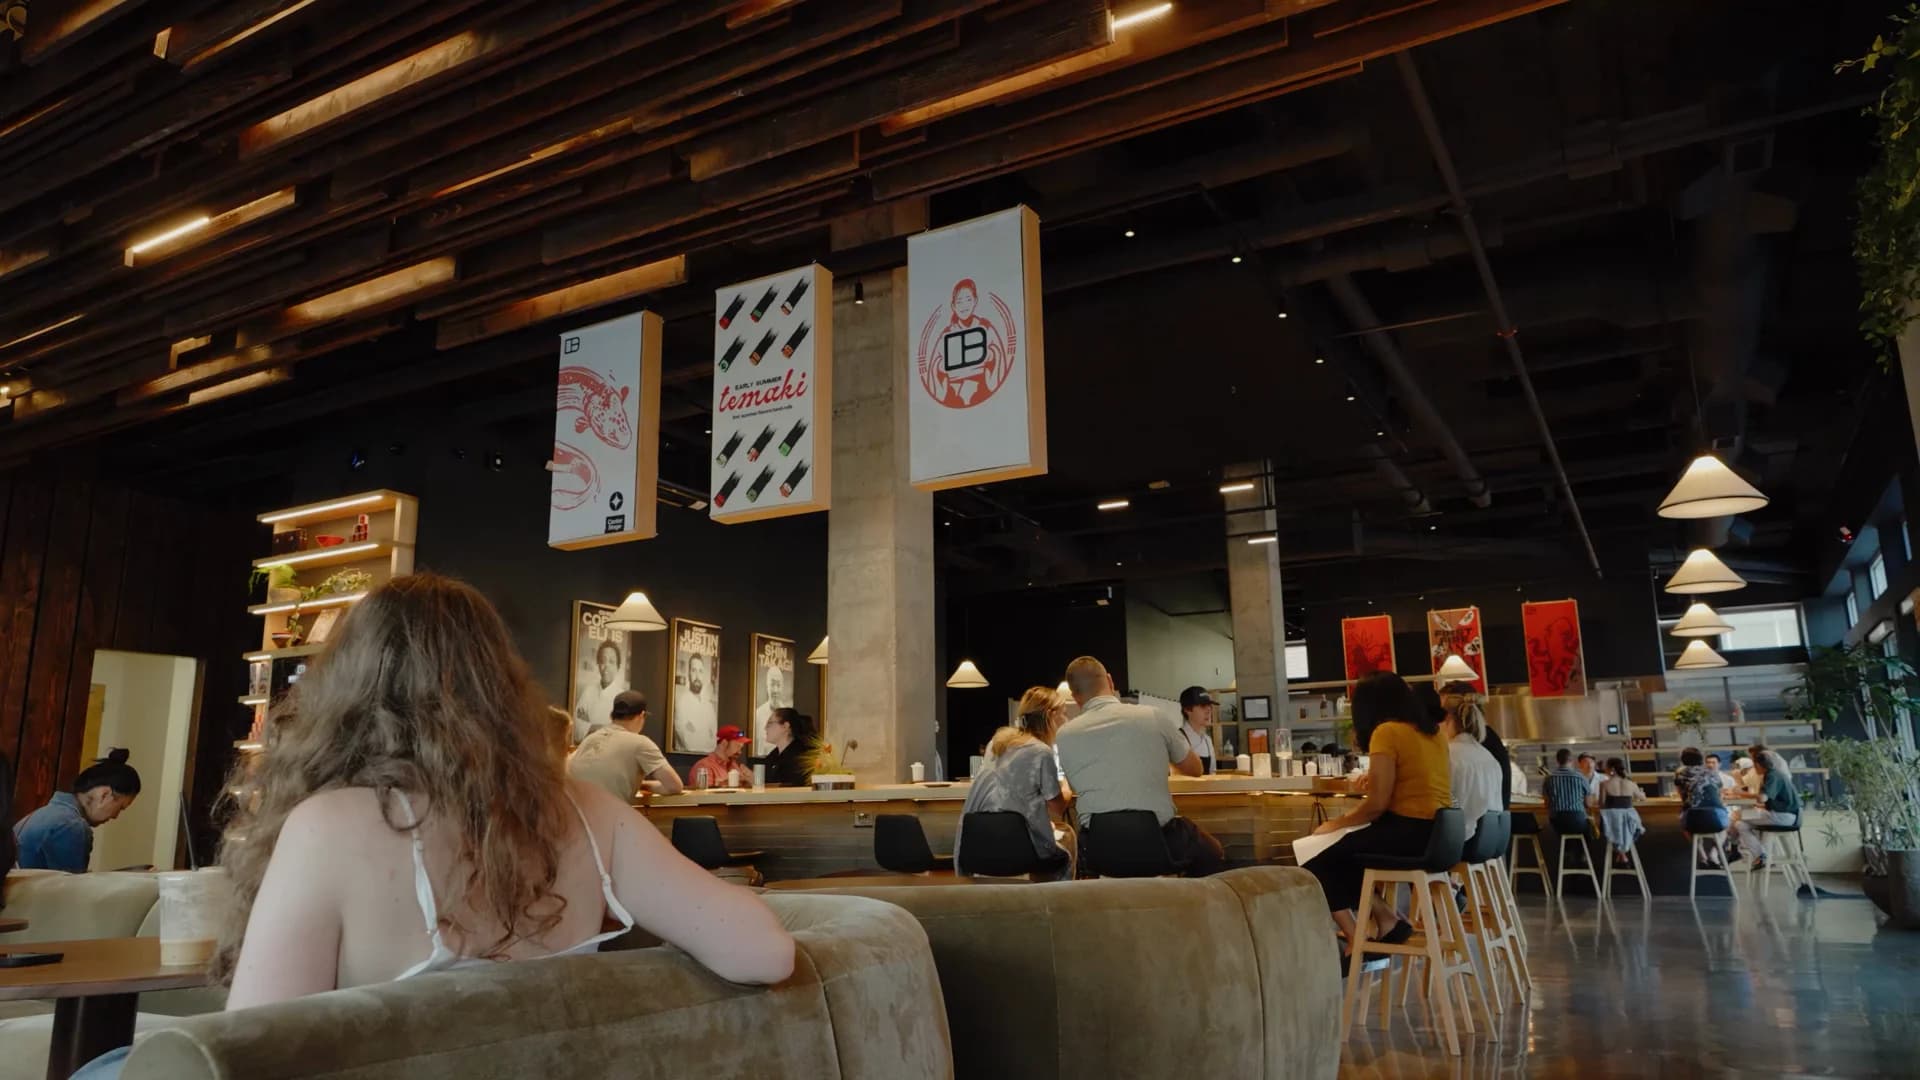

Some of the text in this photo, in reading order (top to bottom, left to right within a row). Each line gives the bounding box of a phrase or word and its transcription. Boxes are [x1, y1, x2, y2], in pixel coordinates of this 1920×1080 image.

[719, 368, 808, 412] temaki
[735, 376, 782, 391] EARLY SUMMER
[680, 629, 719, 649] JUSTIN
[765, 644, 788, 660] SHIN
